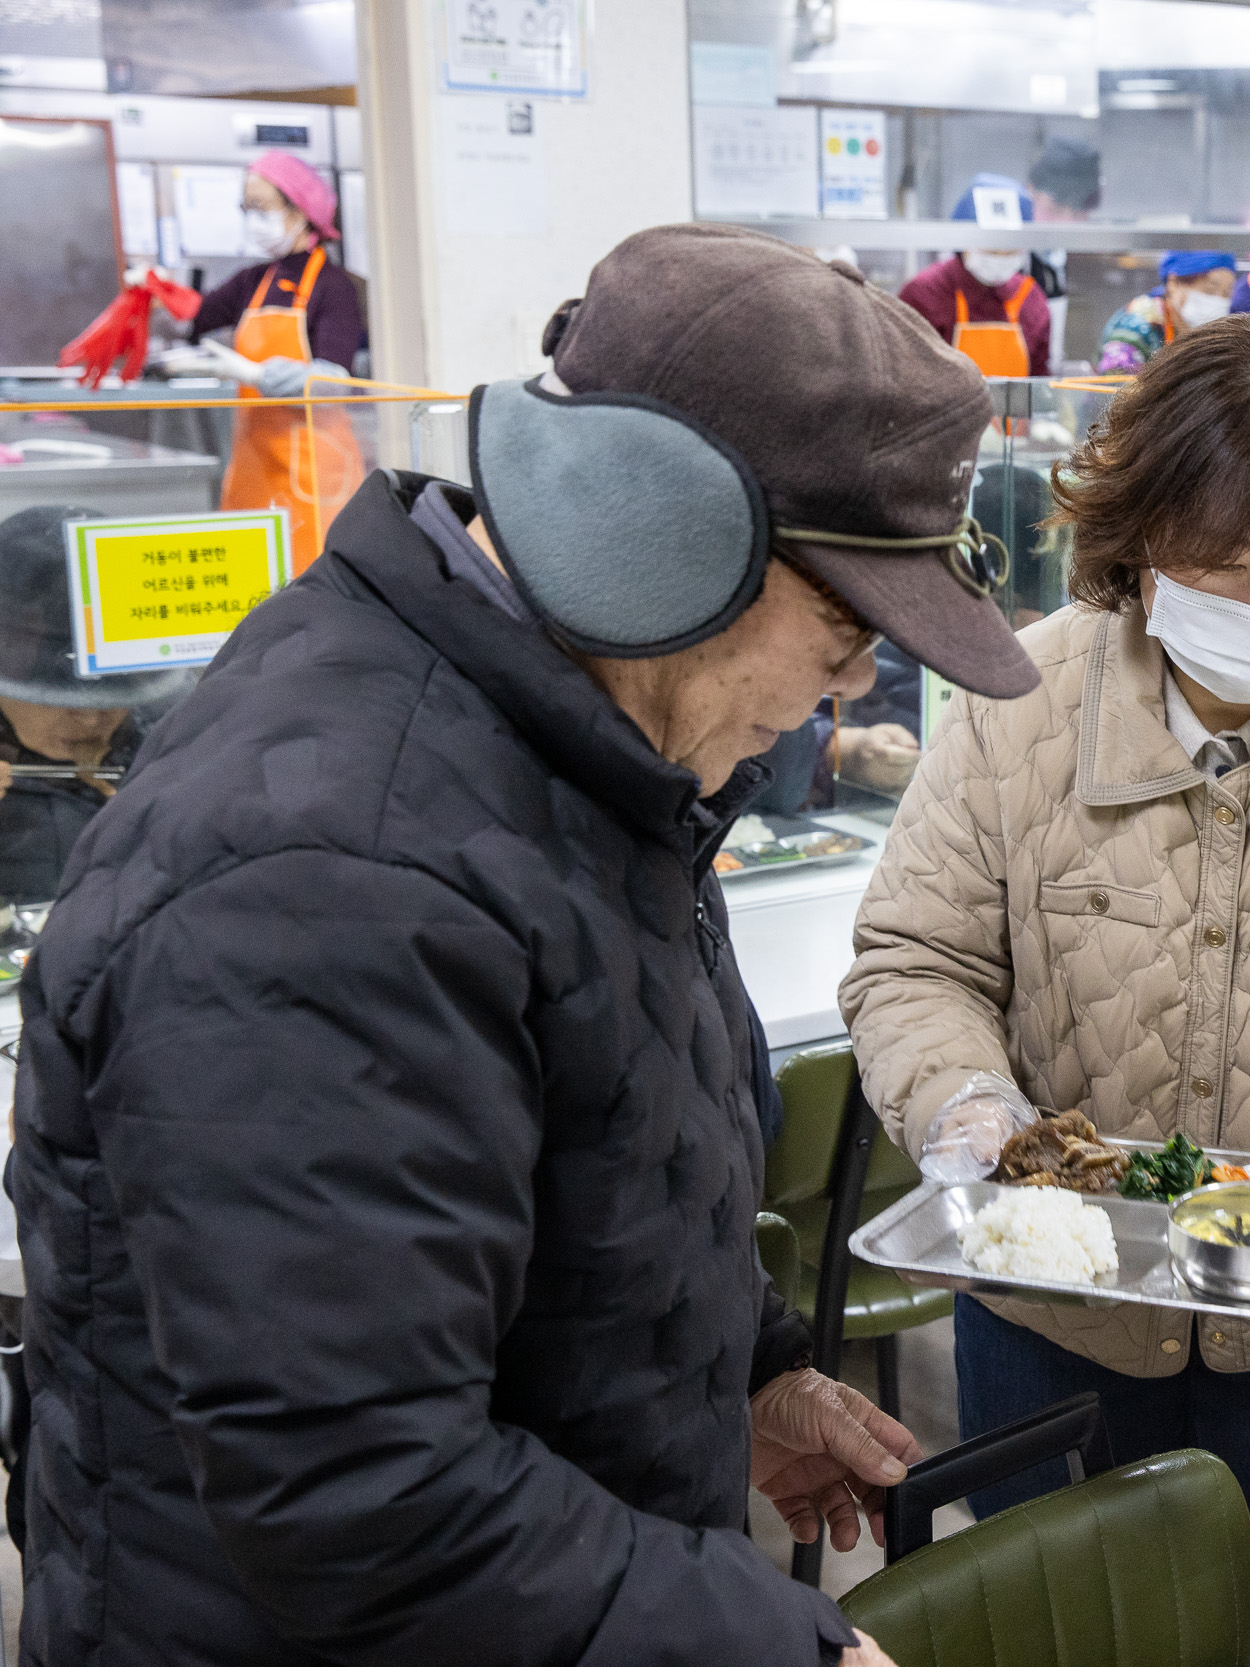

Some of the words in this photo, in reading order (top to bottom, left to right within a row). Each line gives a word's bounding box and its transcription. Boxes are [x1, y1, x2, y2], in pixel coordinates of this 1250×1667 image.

[142, 549, 183, 567] 거동이
[187, 546, 227, 564] 불편한
[142, 575, 197, 593] 어르신을
[202, 572, 230, 589] 위해
[129, 604, 171, 622] 자리를
